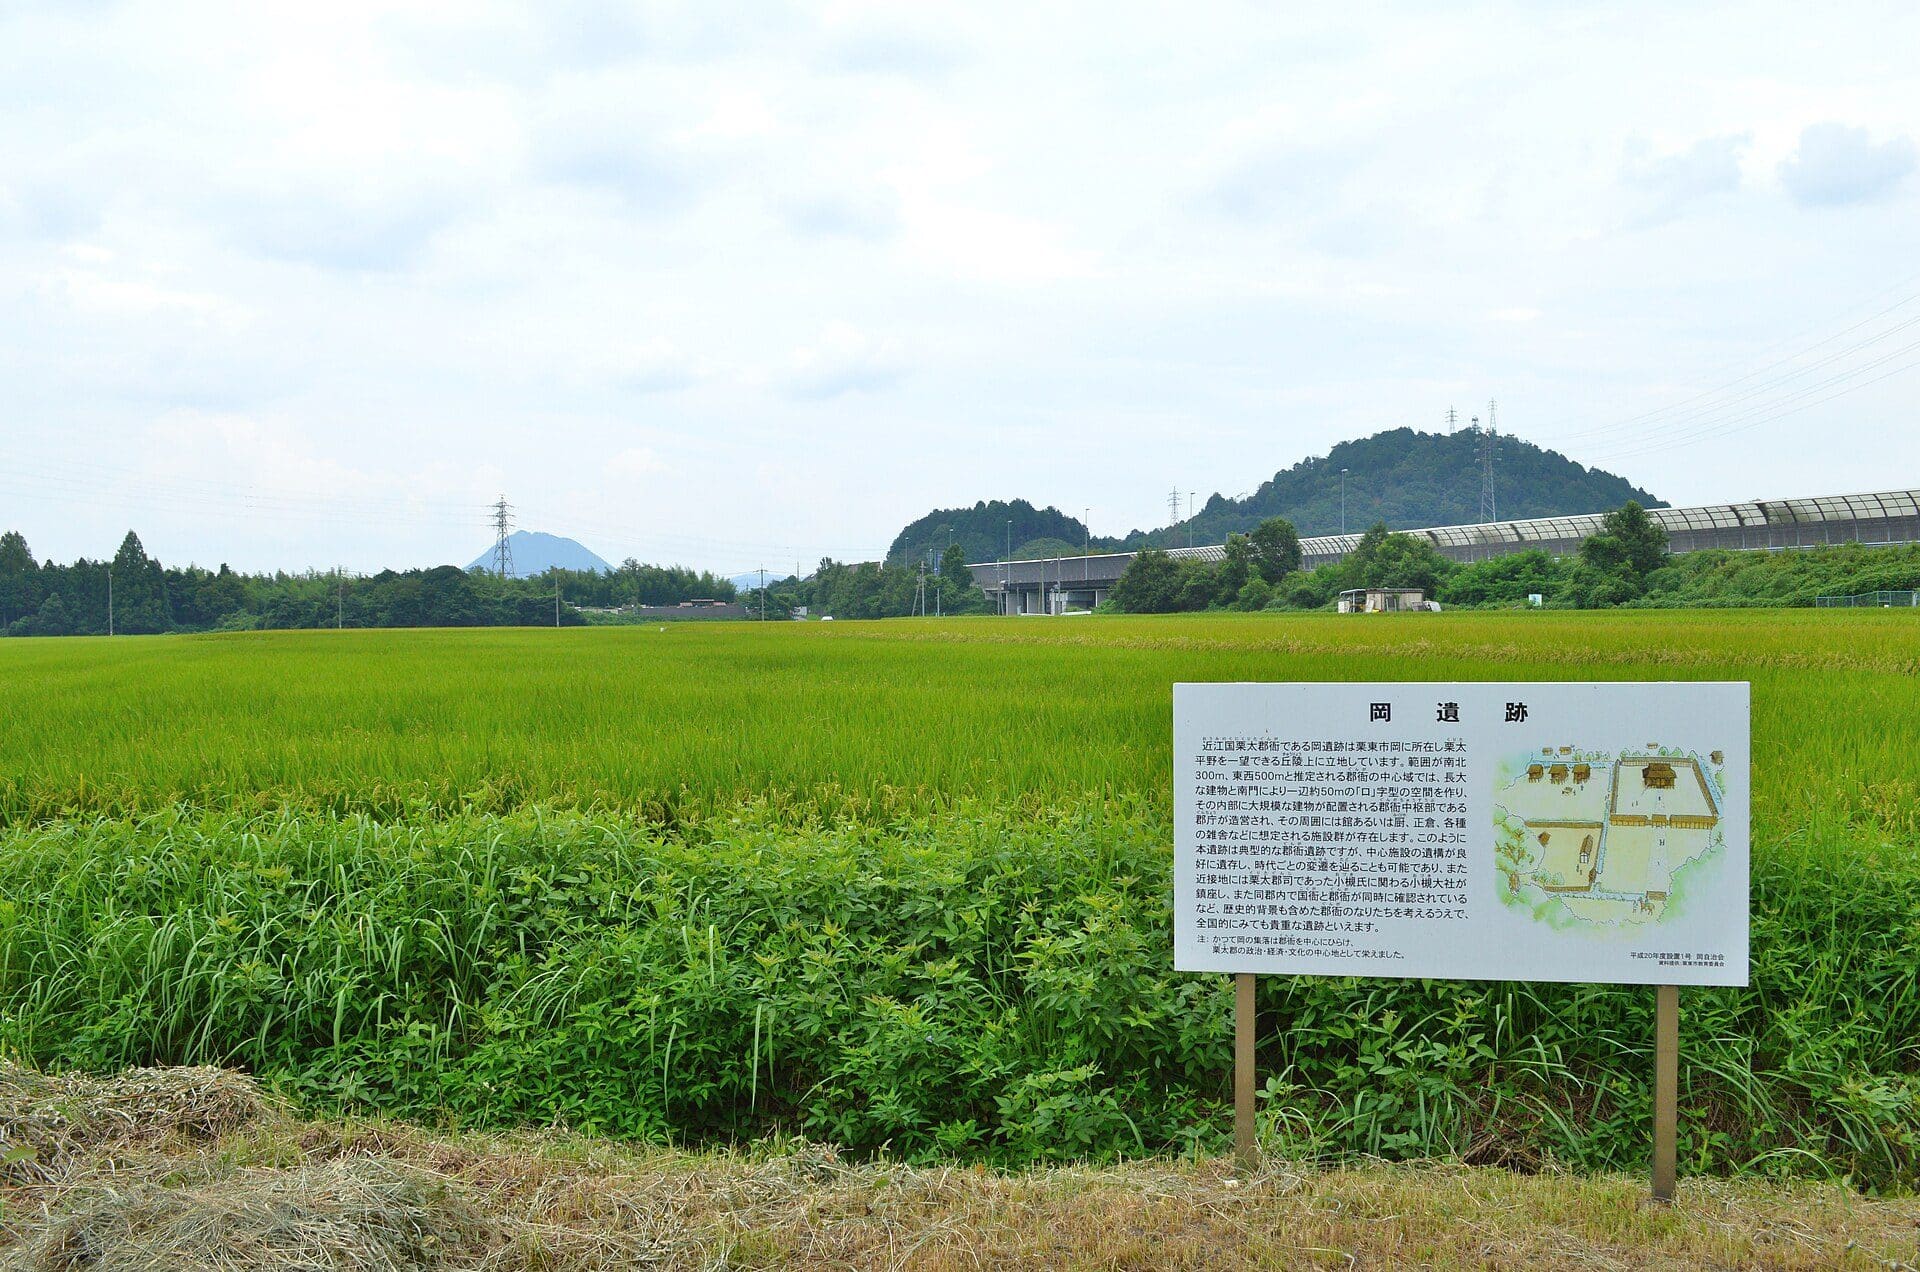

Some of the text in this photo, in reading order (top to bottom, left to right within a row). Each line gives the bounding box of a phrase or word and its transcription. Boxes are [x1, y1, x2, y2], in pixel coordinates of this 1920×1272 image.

[1370, 702, 1528, 722] 岡遺跡
[1195, 756, 1467, 767] 平野を一望できる丘陵上に立地しています。範囲が南北
[1195, 771, 1467, 783] 300m、東西500mと推定される郡衙の中心域では、長大
[1195, 800, 1467, 813] その内部に大規模な建物が配置される郡衙中枢部である
[1195, 830, 1467, 843] の雑舎などに想定される施設群が存在します。このように
[1195, 844, 1467, 858] 本遺跡は典型的な郡衙遺跡ですが、中心施設の遺構が良
[1195, 918, 1379, 933] 全国的にみても貴重な遺跡といえます。
